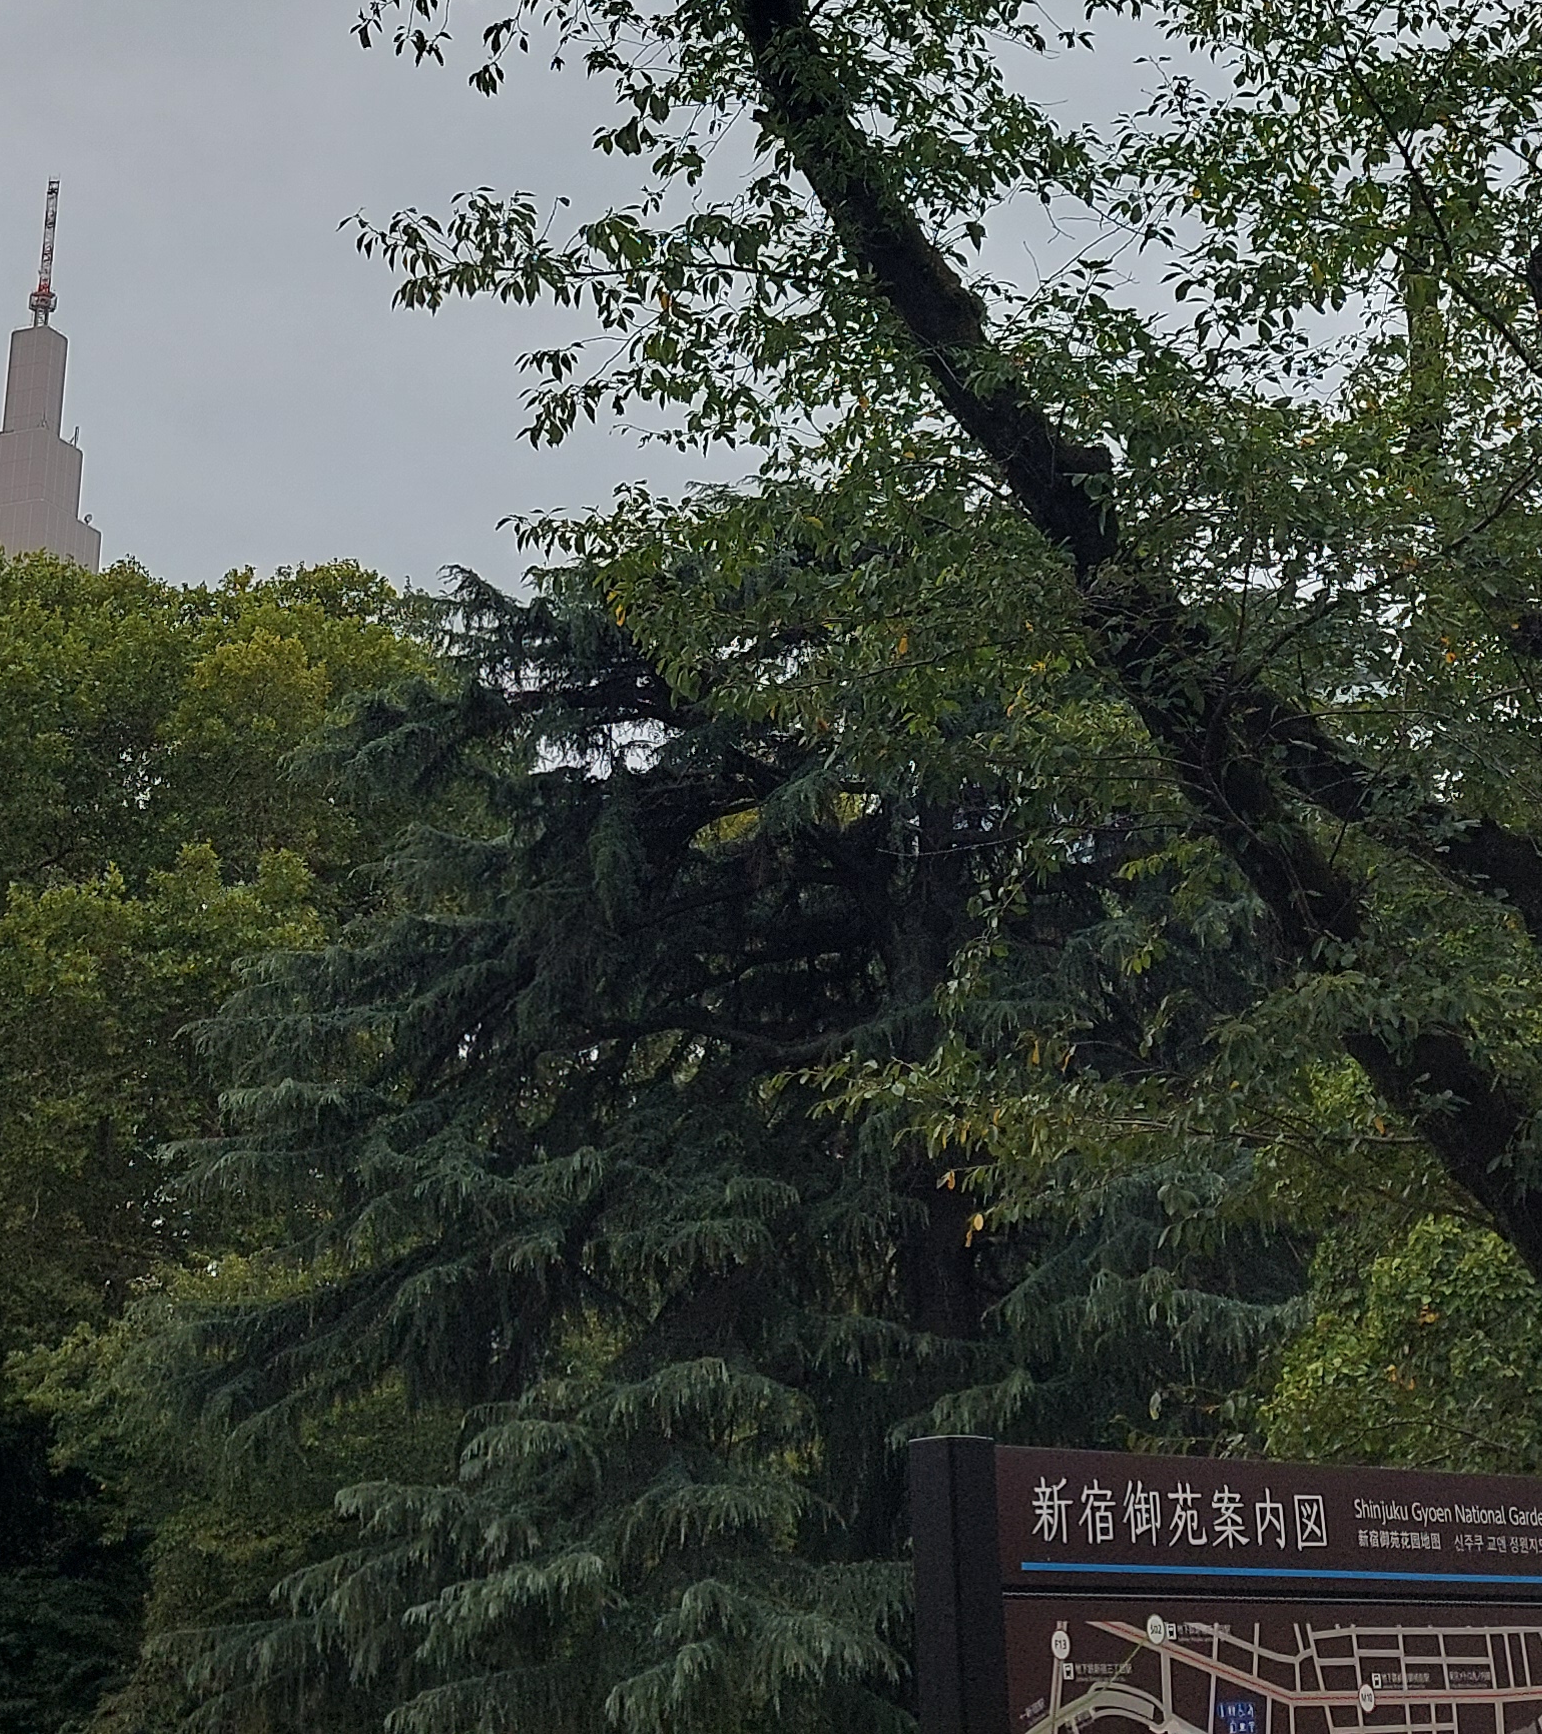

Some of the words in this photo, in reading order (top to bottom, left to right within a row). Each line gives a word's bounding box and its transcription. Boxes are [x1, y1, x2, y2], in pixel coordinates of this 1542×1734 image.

[1031, 1475, 1328, 1551] 新宿御苑案内図
[1354, 1498, 1409, 1525] Shinjuku
[1411, 1502, 1452, 1527] Gyoen
[1454, 1503, 1507, 1525] National
[1454, 1533, 1484, 1552] 신주쿠
[1054, 1639, 1067, 1650] F13
